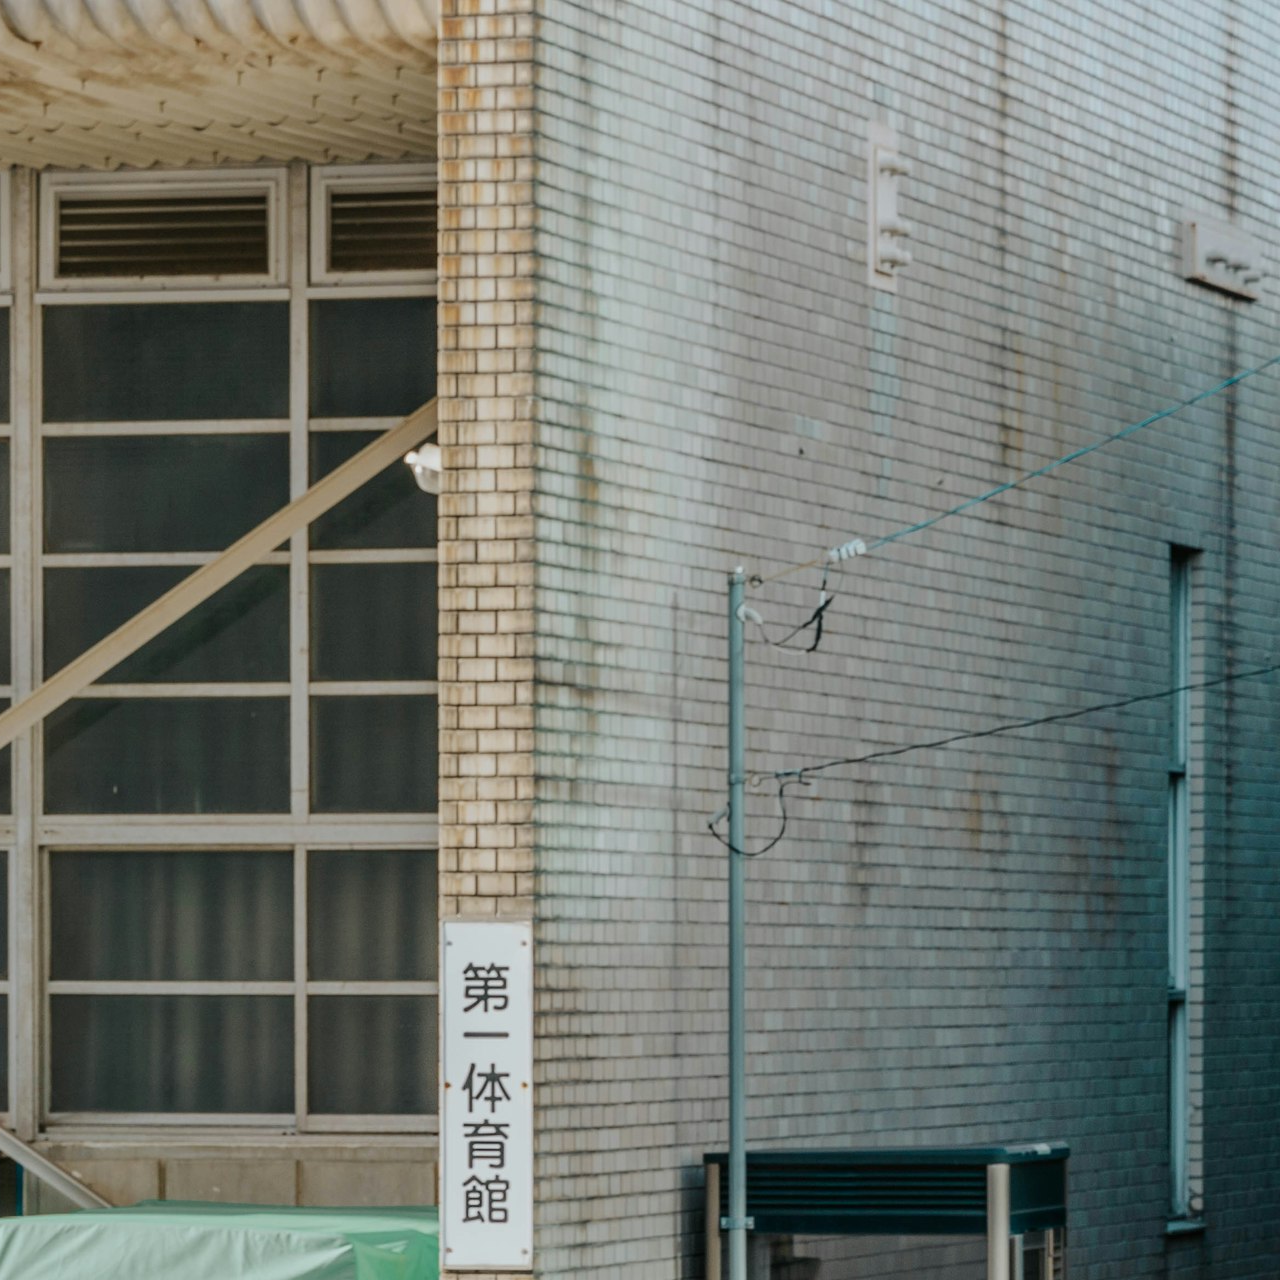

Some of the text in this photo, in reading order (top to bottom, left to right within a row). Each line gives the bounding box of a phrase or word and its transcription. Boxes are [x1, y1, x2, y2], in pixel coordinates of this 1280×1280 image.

[462, 962, 511, 1223] 第一体育館
